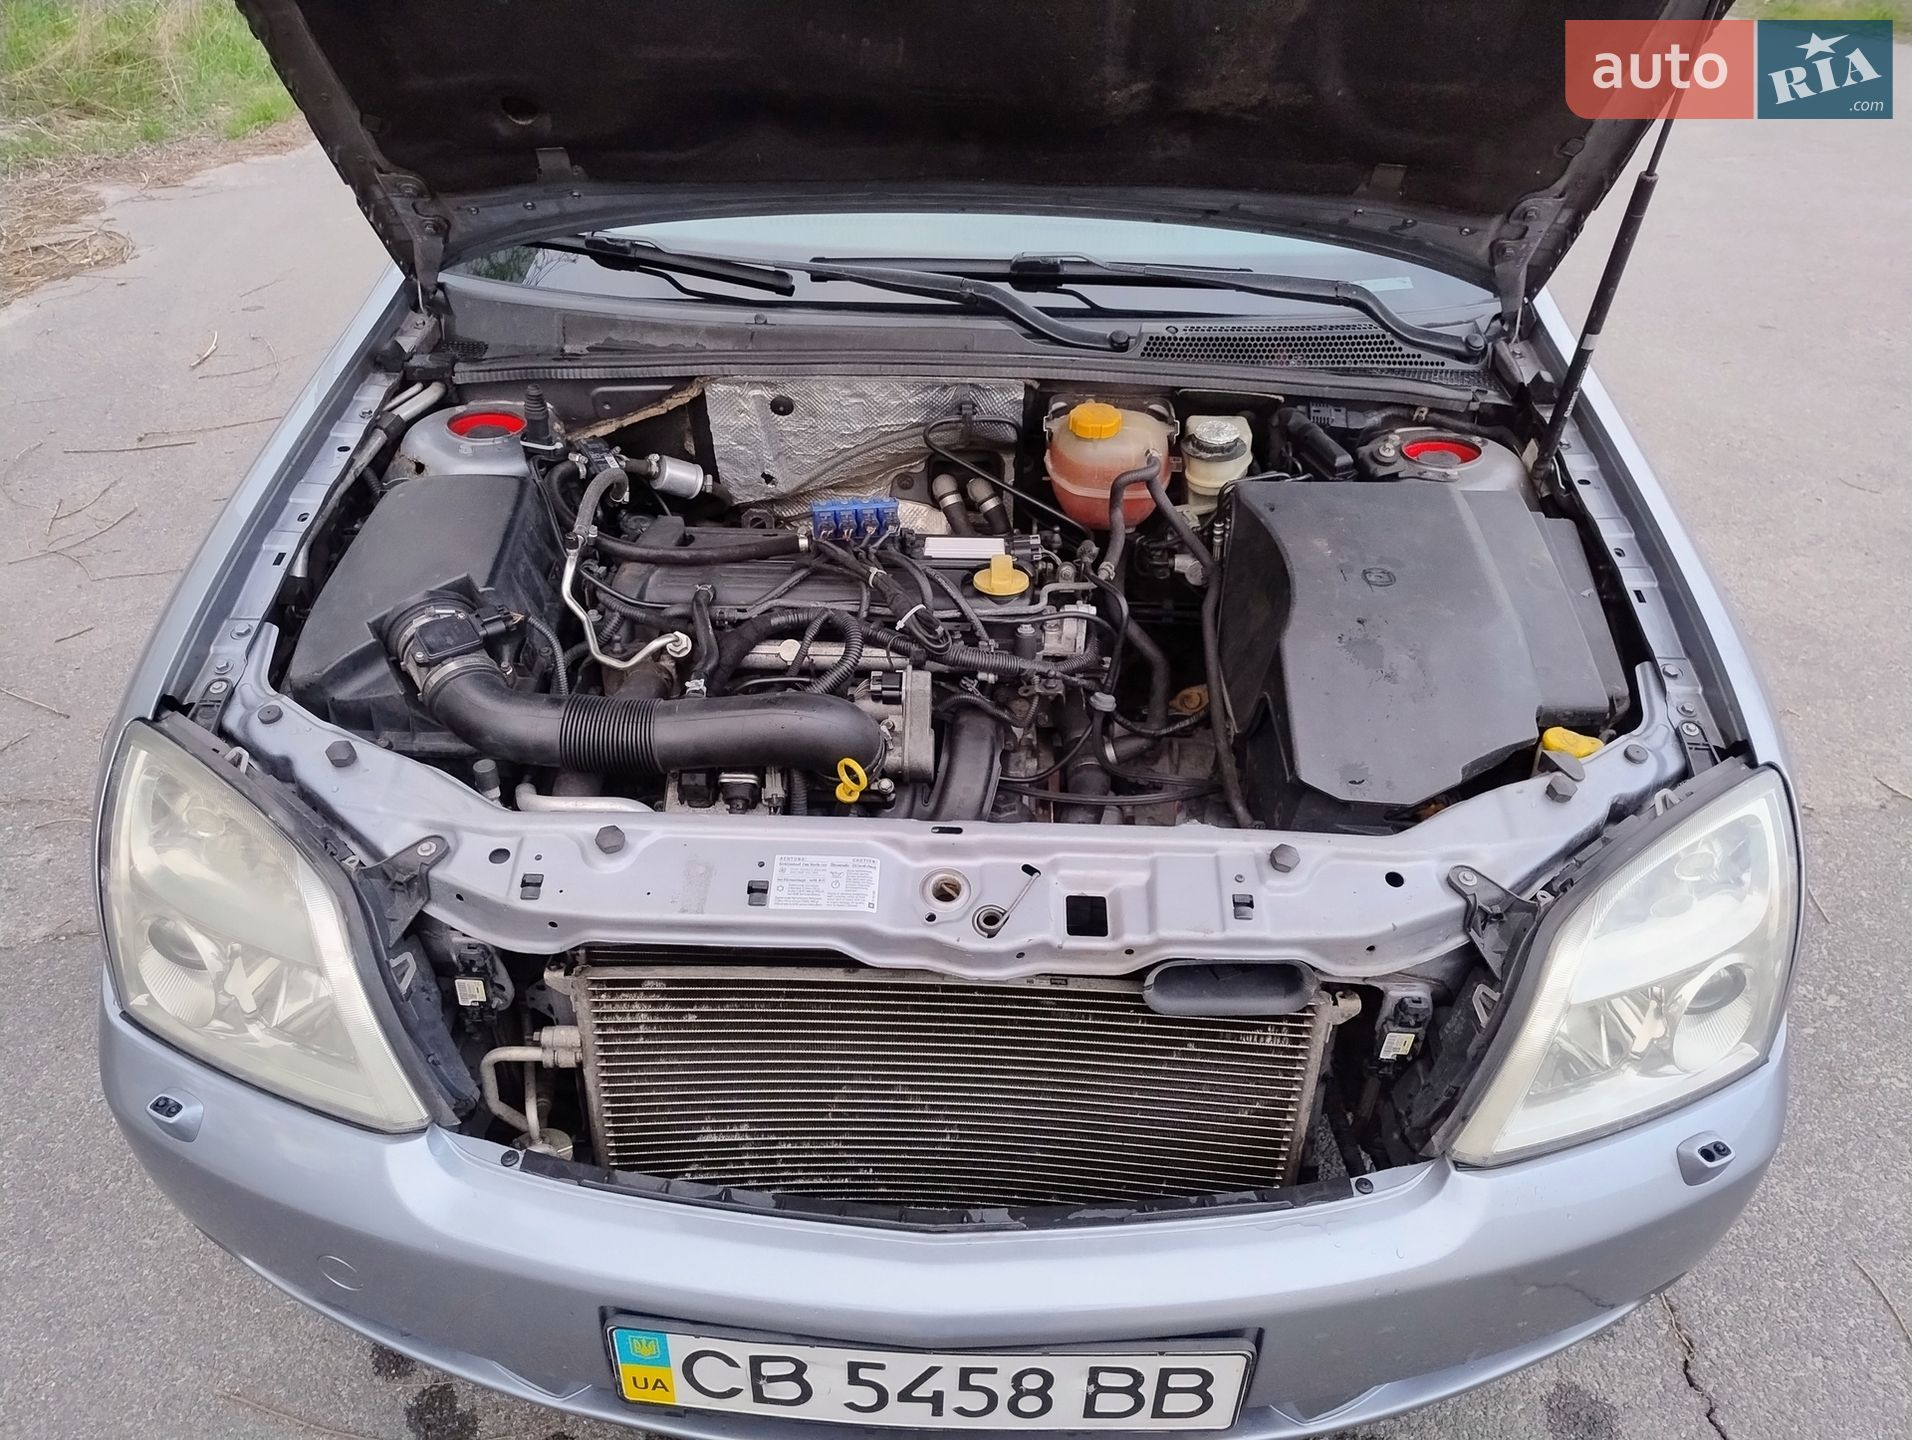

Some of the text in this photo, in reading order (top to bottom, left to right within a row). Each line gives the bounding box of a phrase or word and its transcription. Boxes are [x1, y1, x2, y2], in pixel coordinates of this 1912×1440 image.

[632, 1376, 670, 1393] UA
[681, 1349, 1216, 1419] CB 5458 BB
